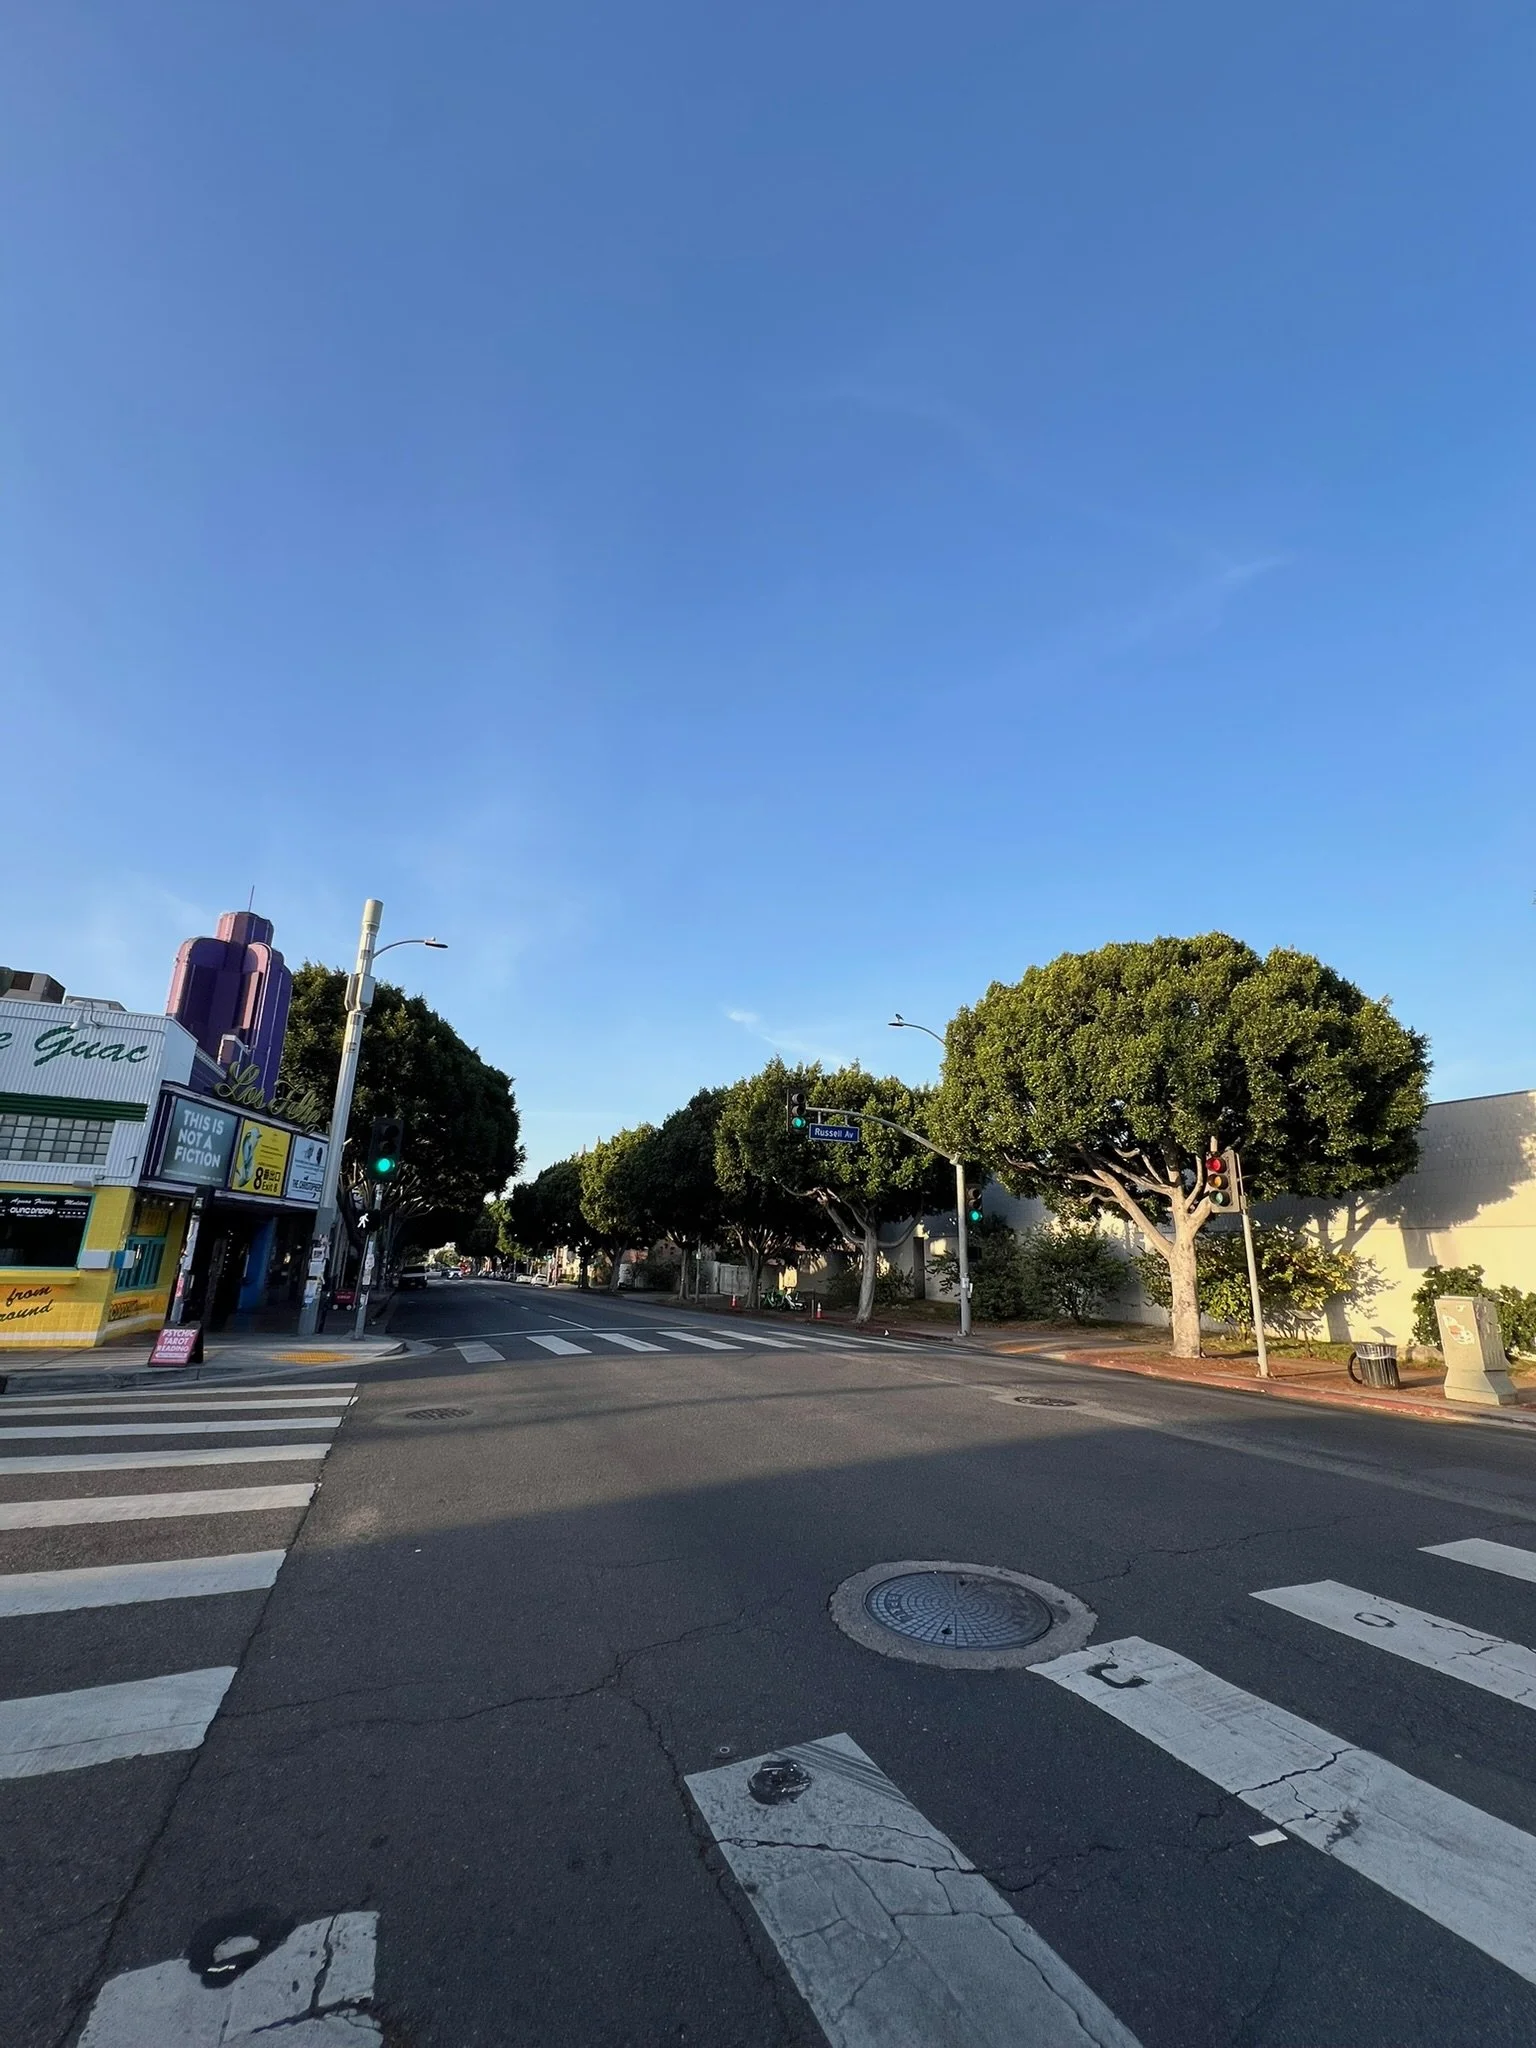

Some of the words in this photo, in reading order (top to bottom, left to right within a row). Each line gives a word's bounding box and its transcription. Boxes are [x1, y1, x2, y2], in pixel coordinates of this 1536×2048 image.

[34, 1025, 149, 1066] Guac
[215, 1061, 266, 1110] Los
[184, 1109, 211, 1131] THIS
[212, 1119, 225, 1136] IS
[814, 1127, 843, 1138] Russell
[844, 1130, 854, 1138] Av
[178, 1128, 203, 1147] NOT
[203, 1136, 213, 1150] A
[174, 1146, 222, 1168] FICTION
[262, 1181, 273, 1191] Exit
[274, 1183, 279, 1192] 8
[6, 1286, 52, 1307] from
[162, 1328, 197, 1337] PSYCHIC
[163, 1337, 190, 1345] TAROT
